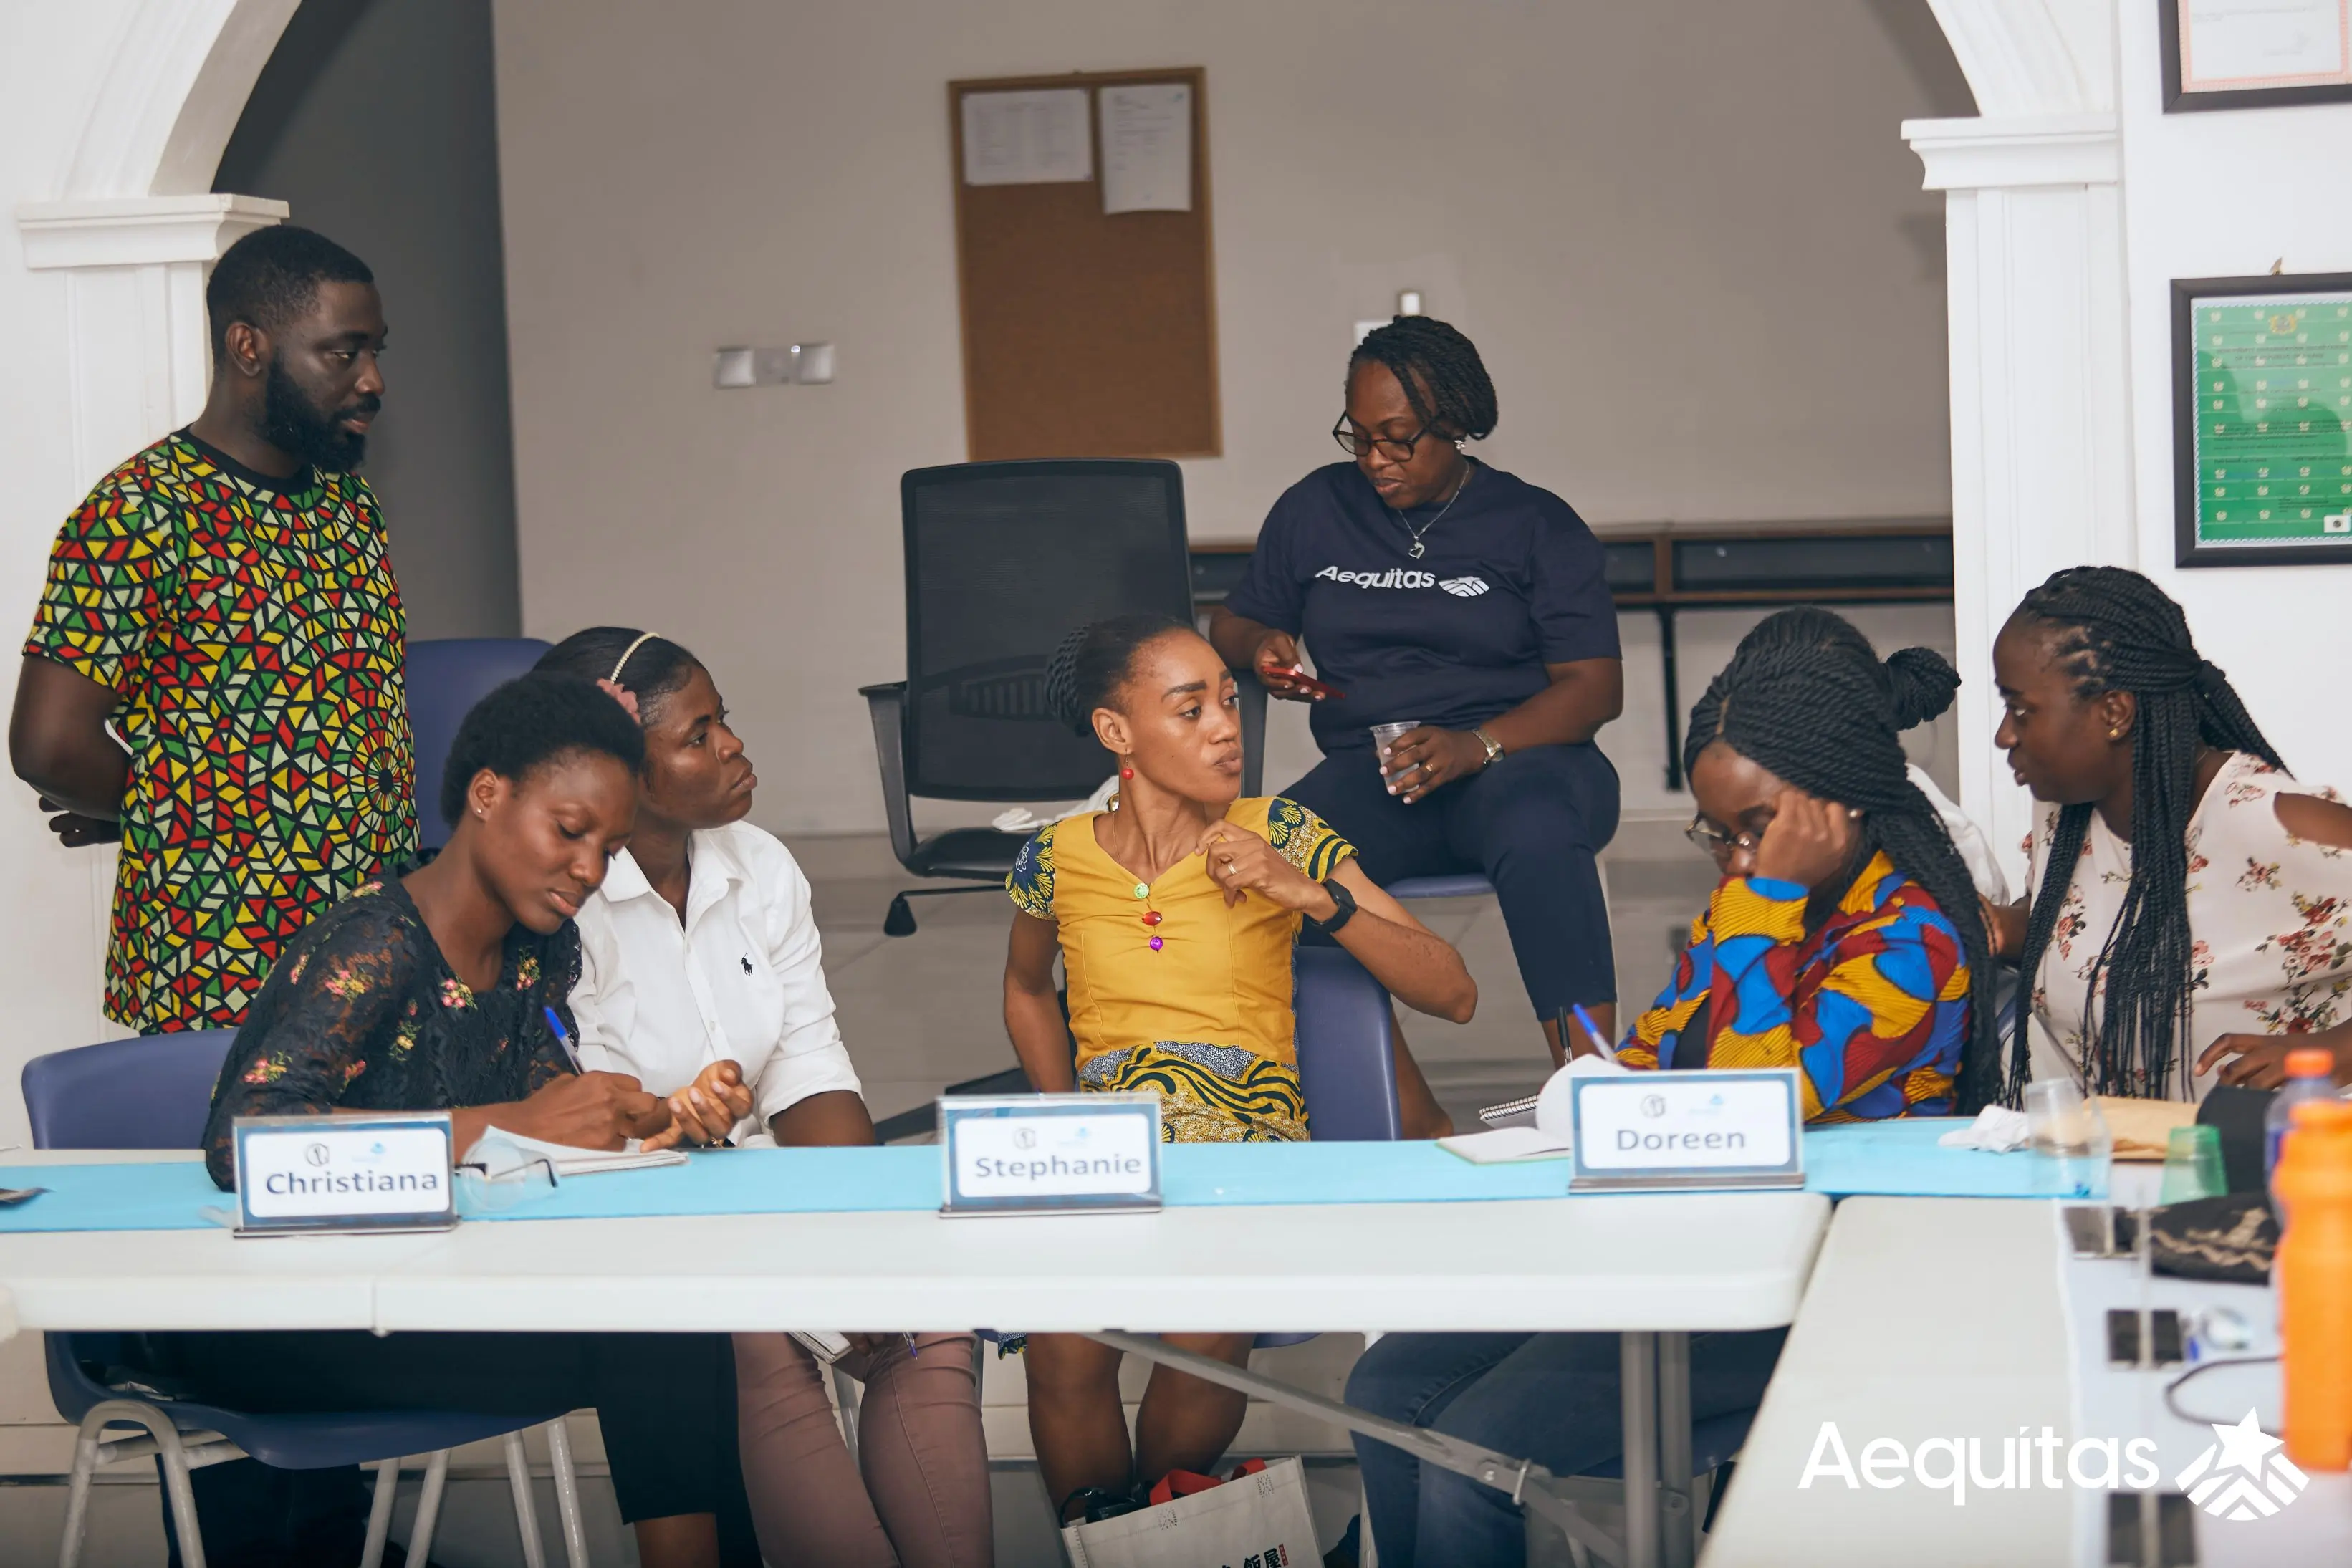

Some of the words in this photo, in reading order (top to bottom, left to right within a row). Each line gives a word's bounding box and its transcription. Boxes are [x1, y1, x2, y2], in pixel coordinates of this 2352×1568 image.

[1616, 1129, 1745, 1151] Doreen
[975, 1153, 1141, 1181] Stephanie
[266, 1169, 438, 1196] Christiana
